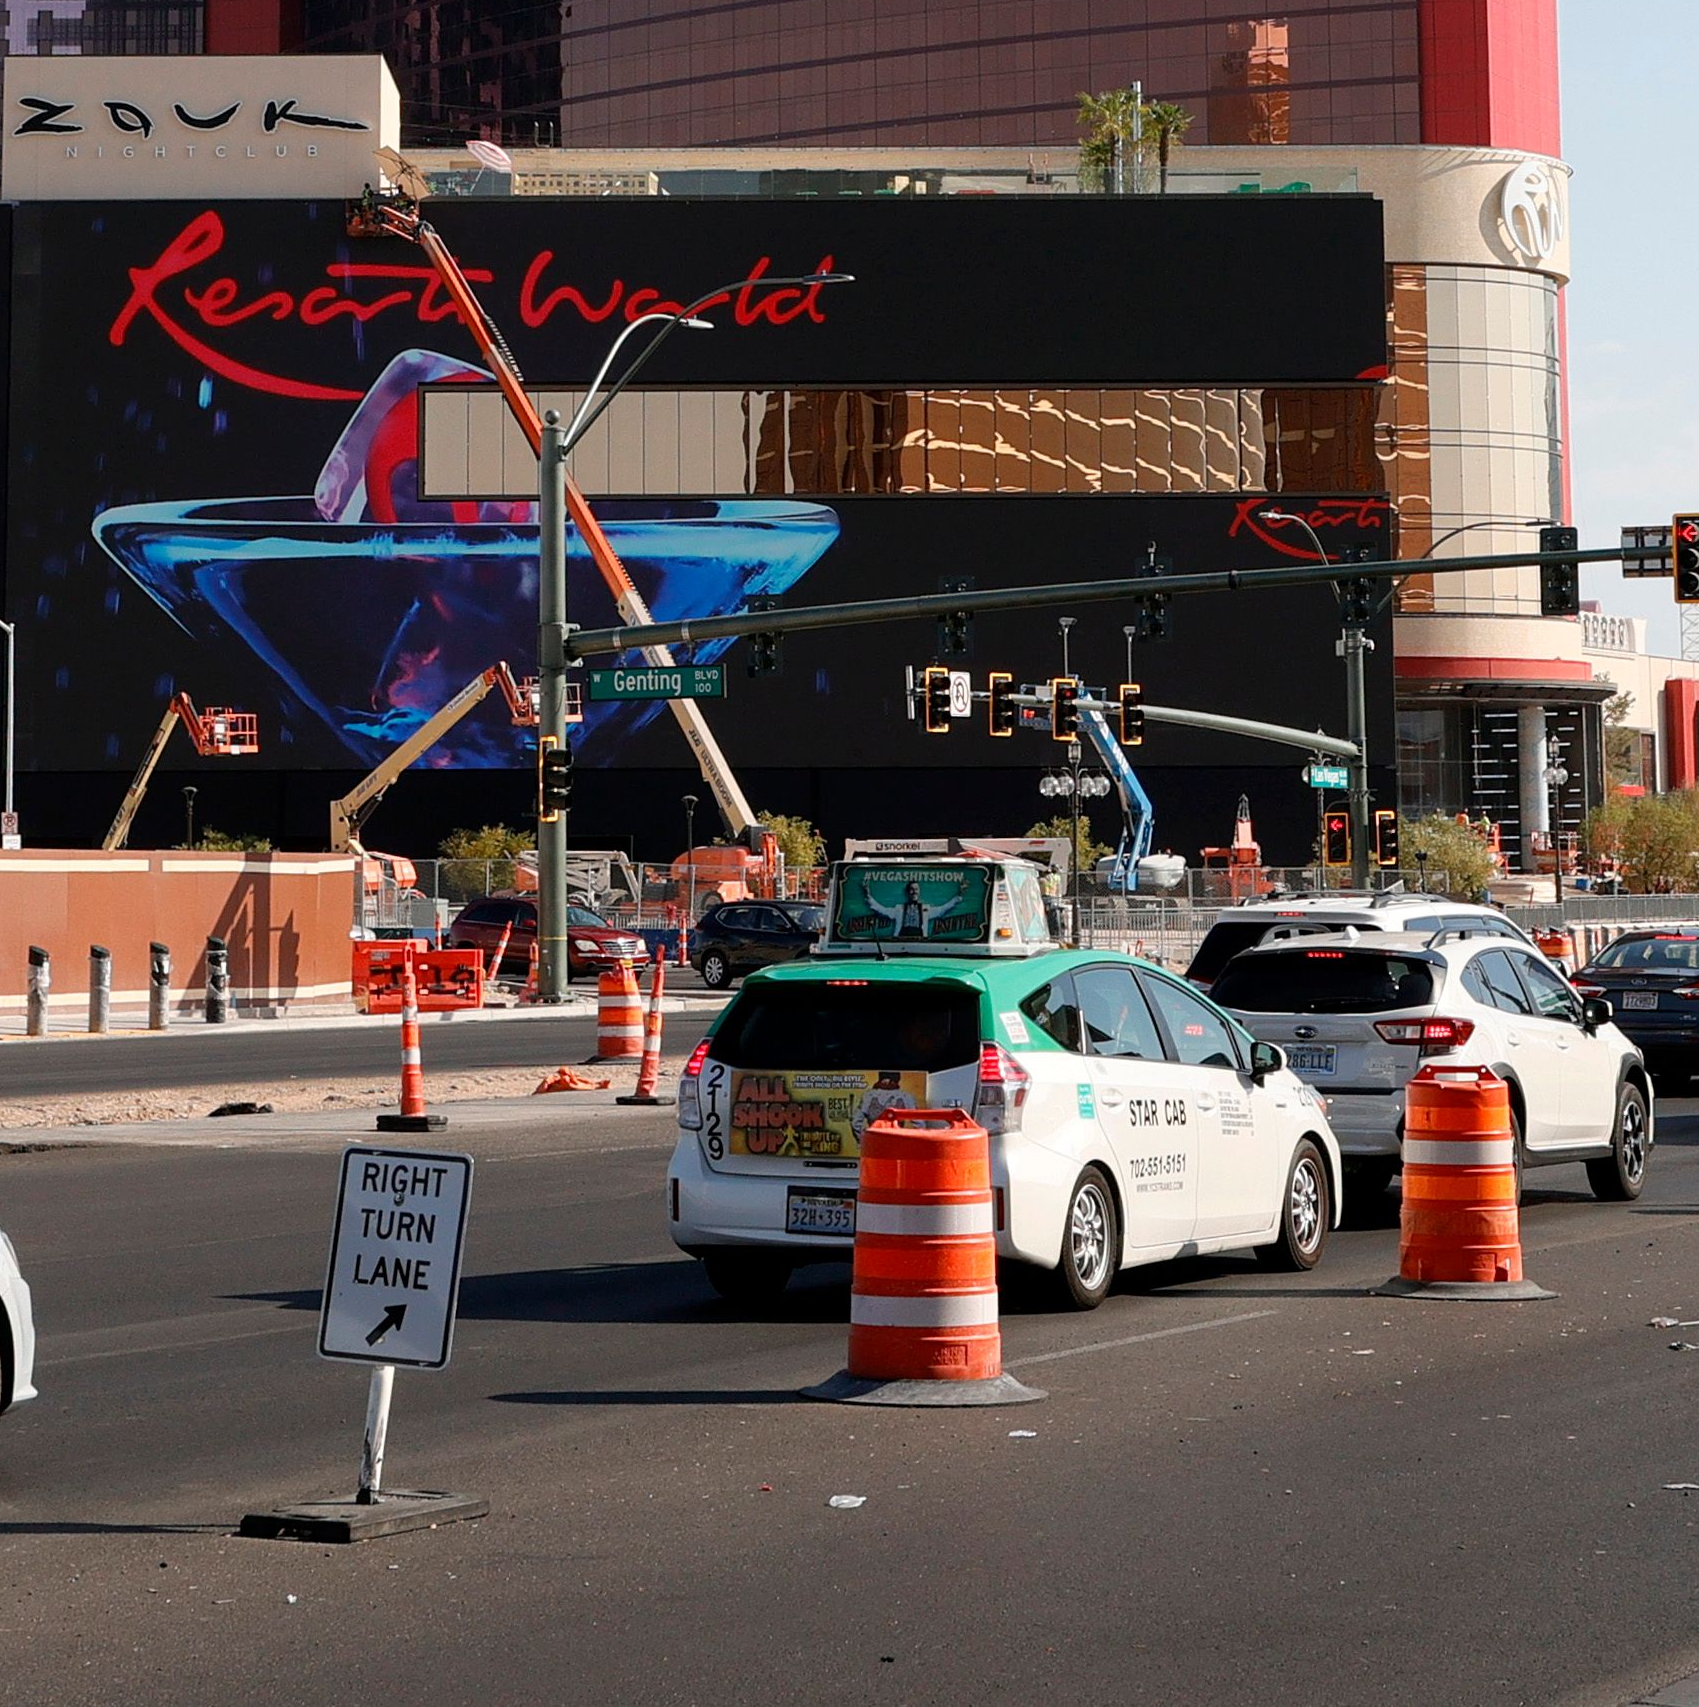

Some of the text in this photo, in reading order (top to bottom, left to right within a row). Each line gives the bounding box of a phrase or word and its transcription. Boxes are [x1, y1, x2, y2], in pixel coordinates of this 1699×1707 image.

[12, 96, 373, 140] ZOUK
[66, 145, 319, 159] NIGHTCLUB
[110, 210, 836, 402] Resorts World
[593, 670, 719, 696] W Genting BLVD
[695, 683, 712, 693] 100
[884, 842, 921, 851] snorkel
[864, 871, 964, 883] #VEGASHITSHOW
[737, 1076, 790, 1102] ALL
[706, 1064, 726, 1161] 2129
[731, 1102, 824, 1128] SHOOK
[828, 1098, 847, 1110] BEST
[1129, 1099, 1159, 1126] STAR
[1165, 1099, 1187, 1126] CAB
[747, 1128, 784, 1153] UP
[1130, 1153, 1186, 1179] 702-551-5151
[362, 1162, 448, 1198] RIGHT
[361, 1208, 436, 1244] TURN
[353, 1254, 431, 1291] LANE
